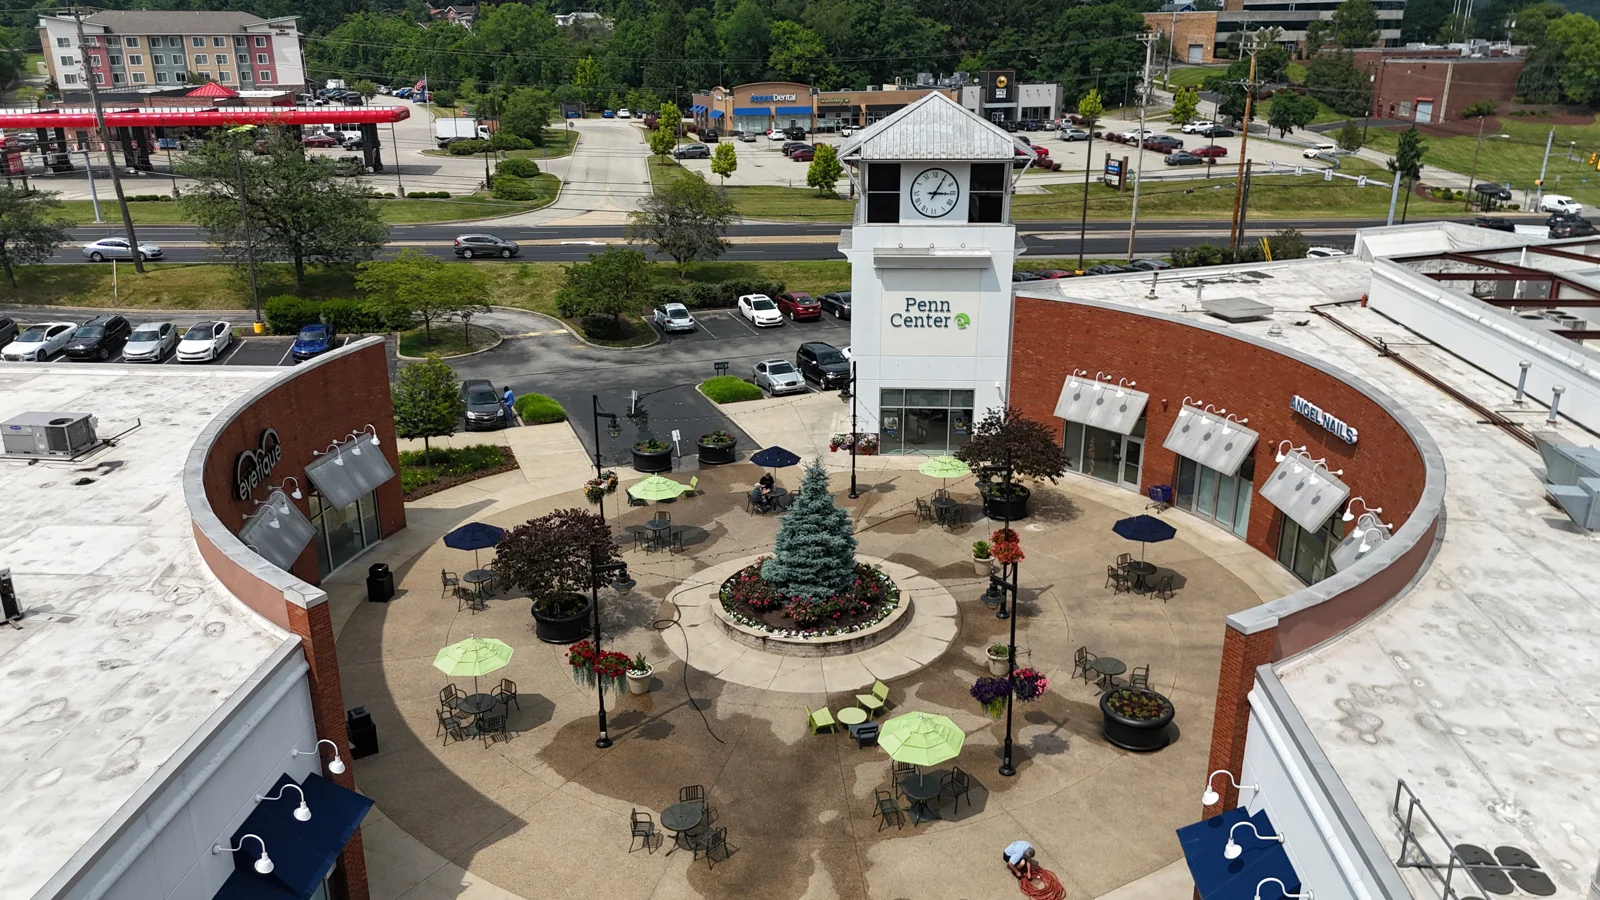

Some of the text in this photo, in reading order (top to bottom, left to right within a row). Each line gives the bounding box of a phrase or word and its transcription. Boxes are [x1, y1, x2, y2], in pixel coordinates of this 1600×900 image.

[890, 312, 951, 328] Center
[904, 297, 951, 312] Penn
[1290, 394, 1358, 444] ANGEL NAILS
[238, 442, 282, 501] eyetique
